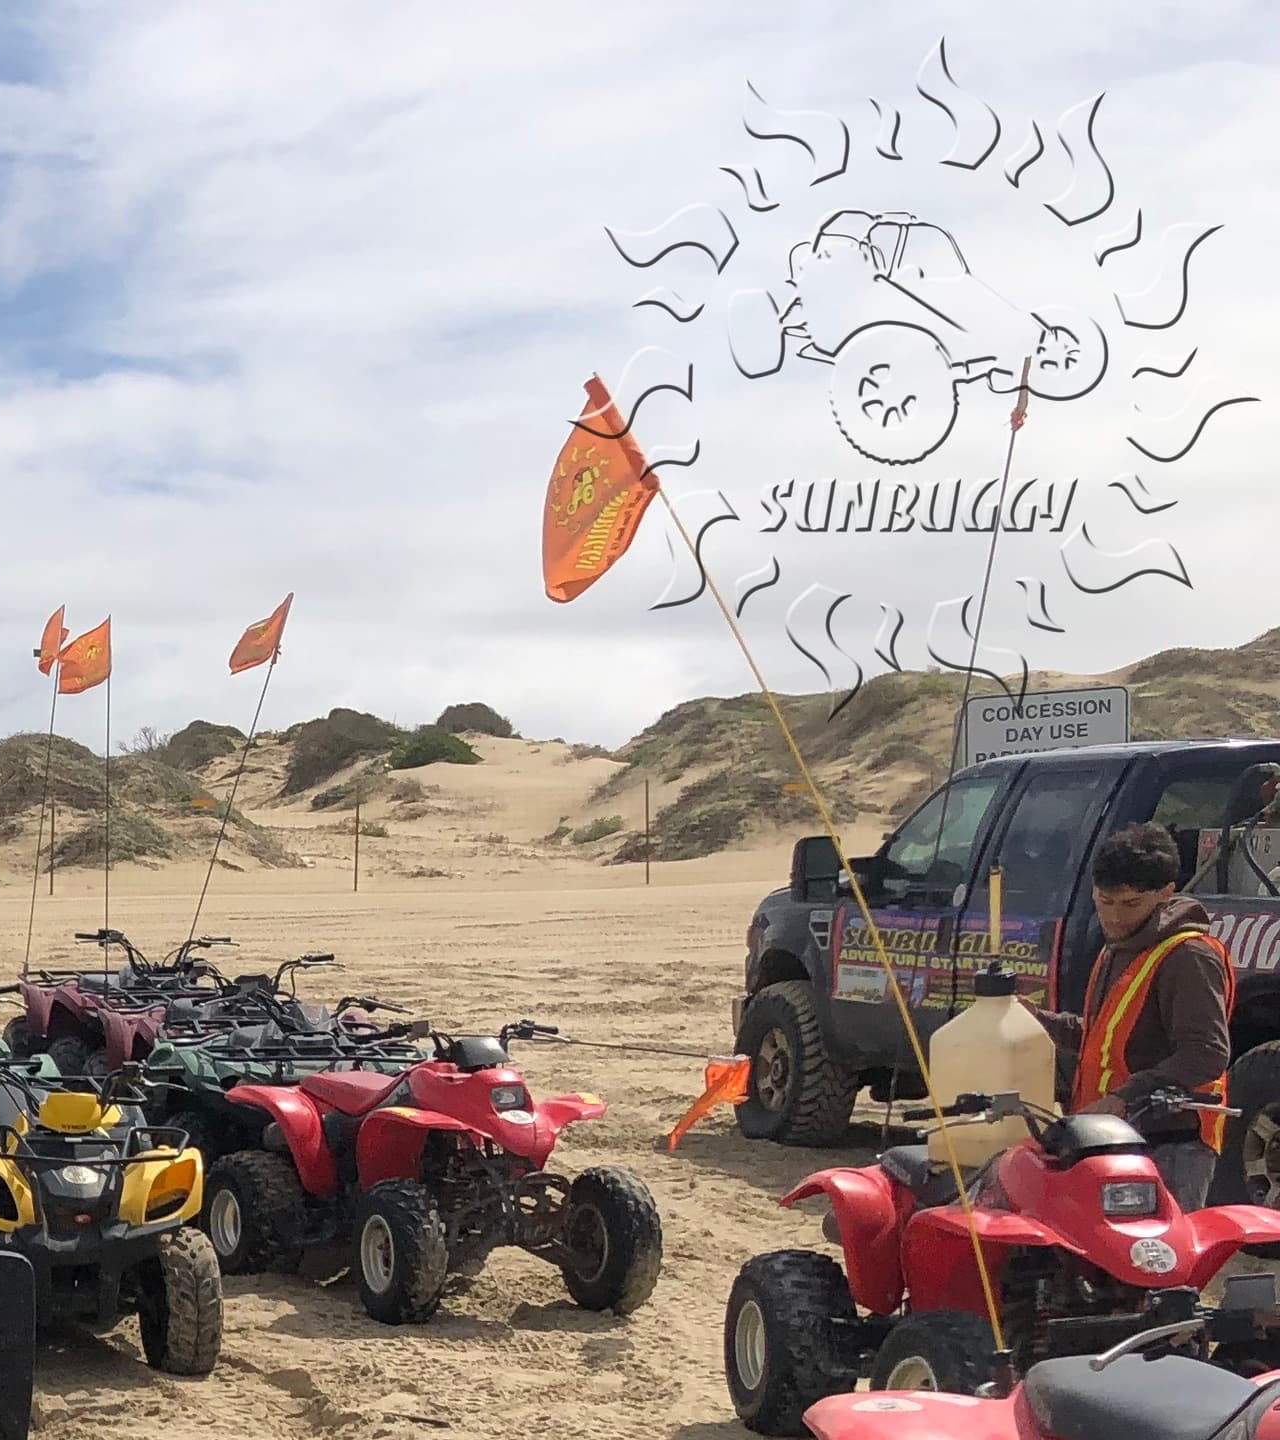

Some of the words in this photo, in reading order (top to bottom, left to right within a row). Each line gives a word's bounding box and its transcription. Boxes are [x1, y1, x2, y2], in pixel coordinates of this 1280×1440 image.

[982, 699, 1112, 723] CONCESSION
[1006, 726, 1044, 743] DAY
[1050, 723, 1089, 740] USE
